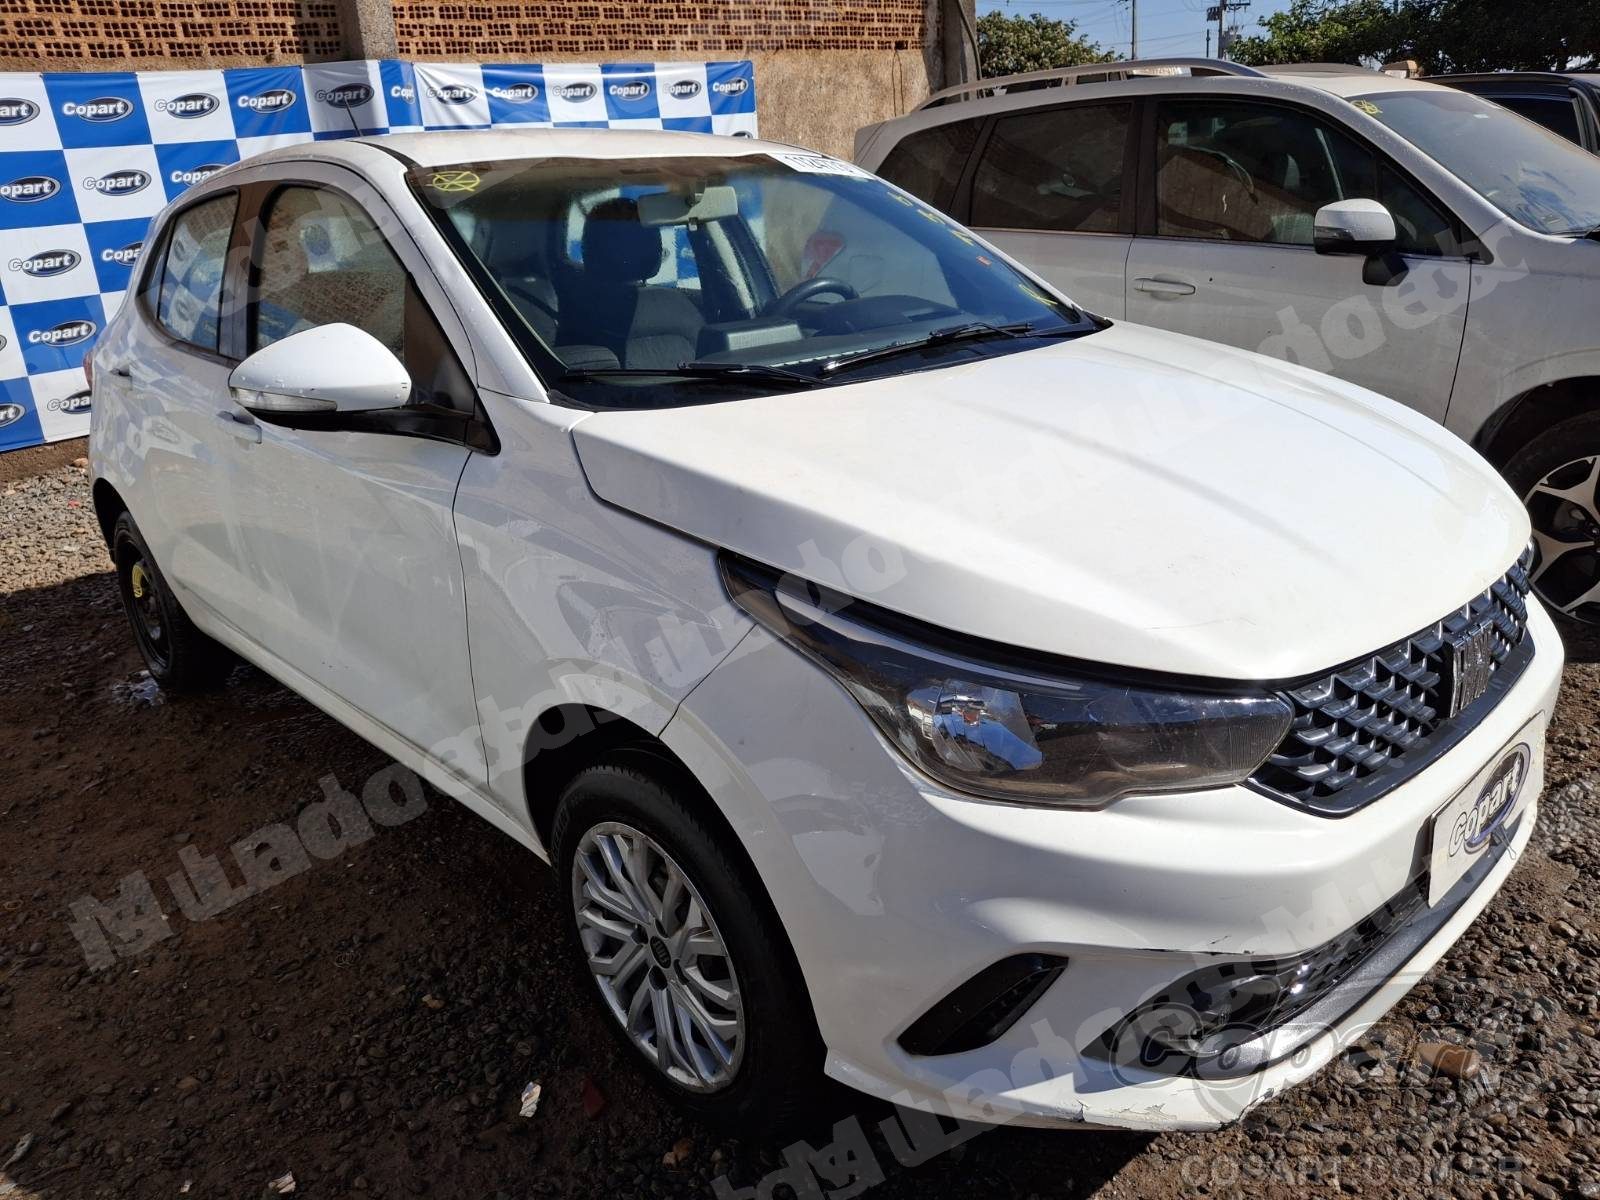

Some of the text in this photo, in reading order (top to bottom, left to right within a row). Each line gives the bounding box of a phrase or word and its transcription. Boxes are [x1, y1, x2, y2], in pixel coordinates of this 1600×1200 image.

[426, 86, 472, 99] Copart
[493, 86, 533, 99] Copart
[552, 85, 592, 98] Copart
[609, 83, 646, 96] Copart
[663, 82, 696, 95] Copart
[712, 80, 745, 92] Copart
[237, 91, 289, 114] Copart
[314, 86, 366, 107] Copart
[0, 102, 29, 117] art
[62, 99, 127, 121] Copart
[155, 93, 211, 118] Copart
[83, 171, 146, 196] Copart
[171, 170, 215, 184] Copa
[0, 181, 51, 198] opart
[102, 248, 143, 262] Copa
[8, 252, 72, 276] Copart
[28, 322, 91, 347] Copart
[47, 396, 90, 412] Copa
[1449, 753, 1521, 857] Copart
